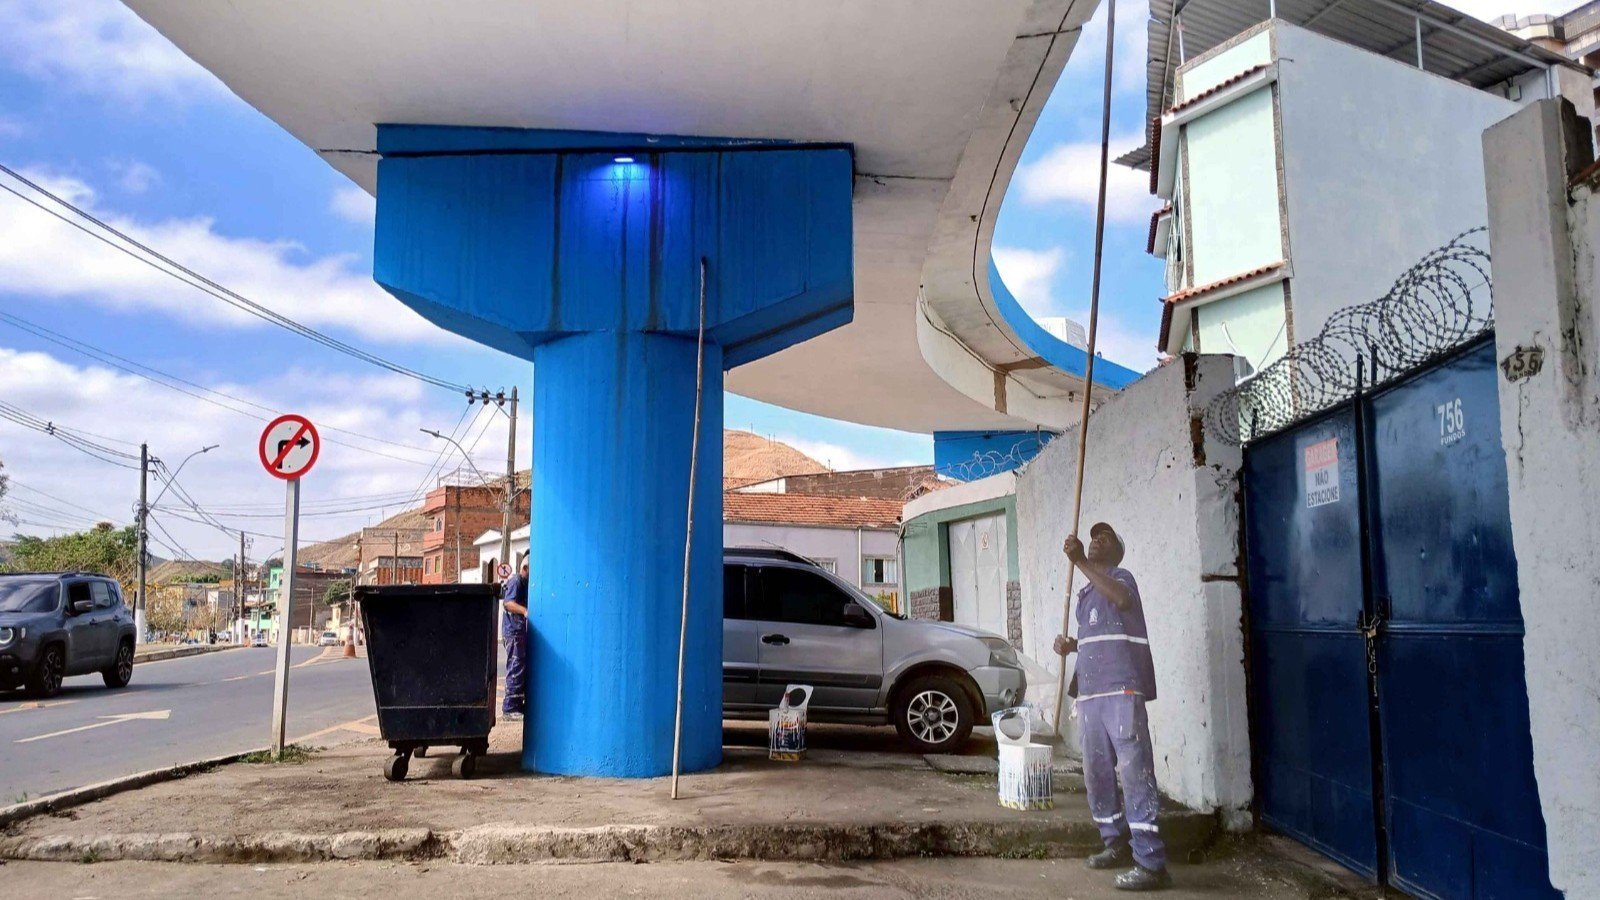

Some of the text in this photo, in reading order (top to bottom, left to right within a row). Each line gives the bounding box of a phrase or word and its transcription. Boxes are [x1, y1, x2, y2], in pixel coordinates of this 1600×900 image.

[1437, 398, 1463, 436] 756
[1441, 429, 1466, 445] FUNDOS
[1315, 467, 1329, 486] NÃO
[1307, 486, 1339, 507] ESTACIONE
